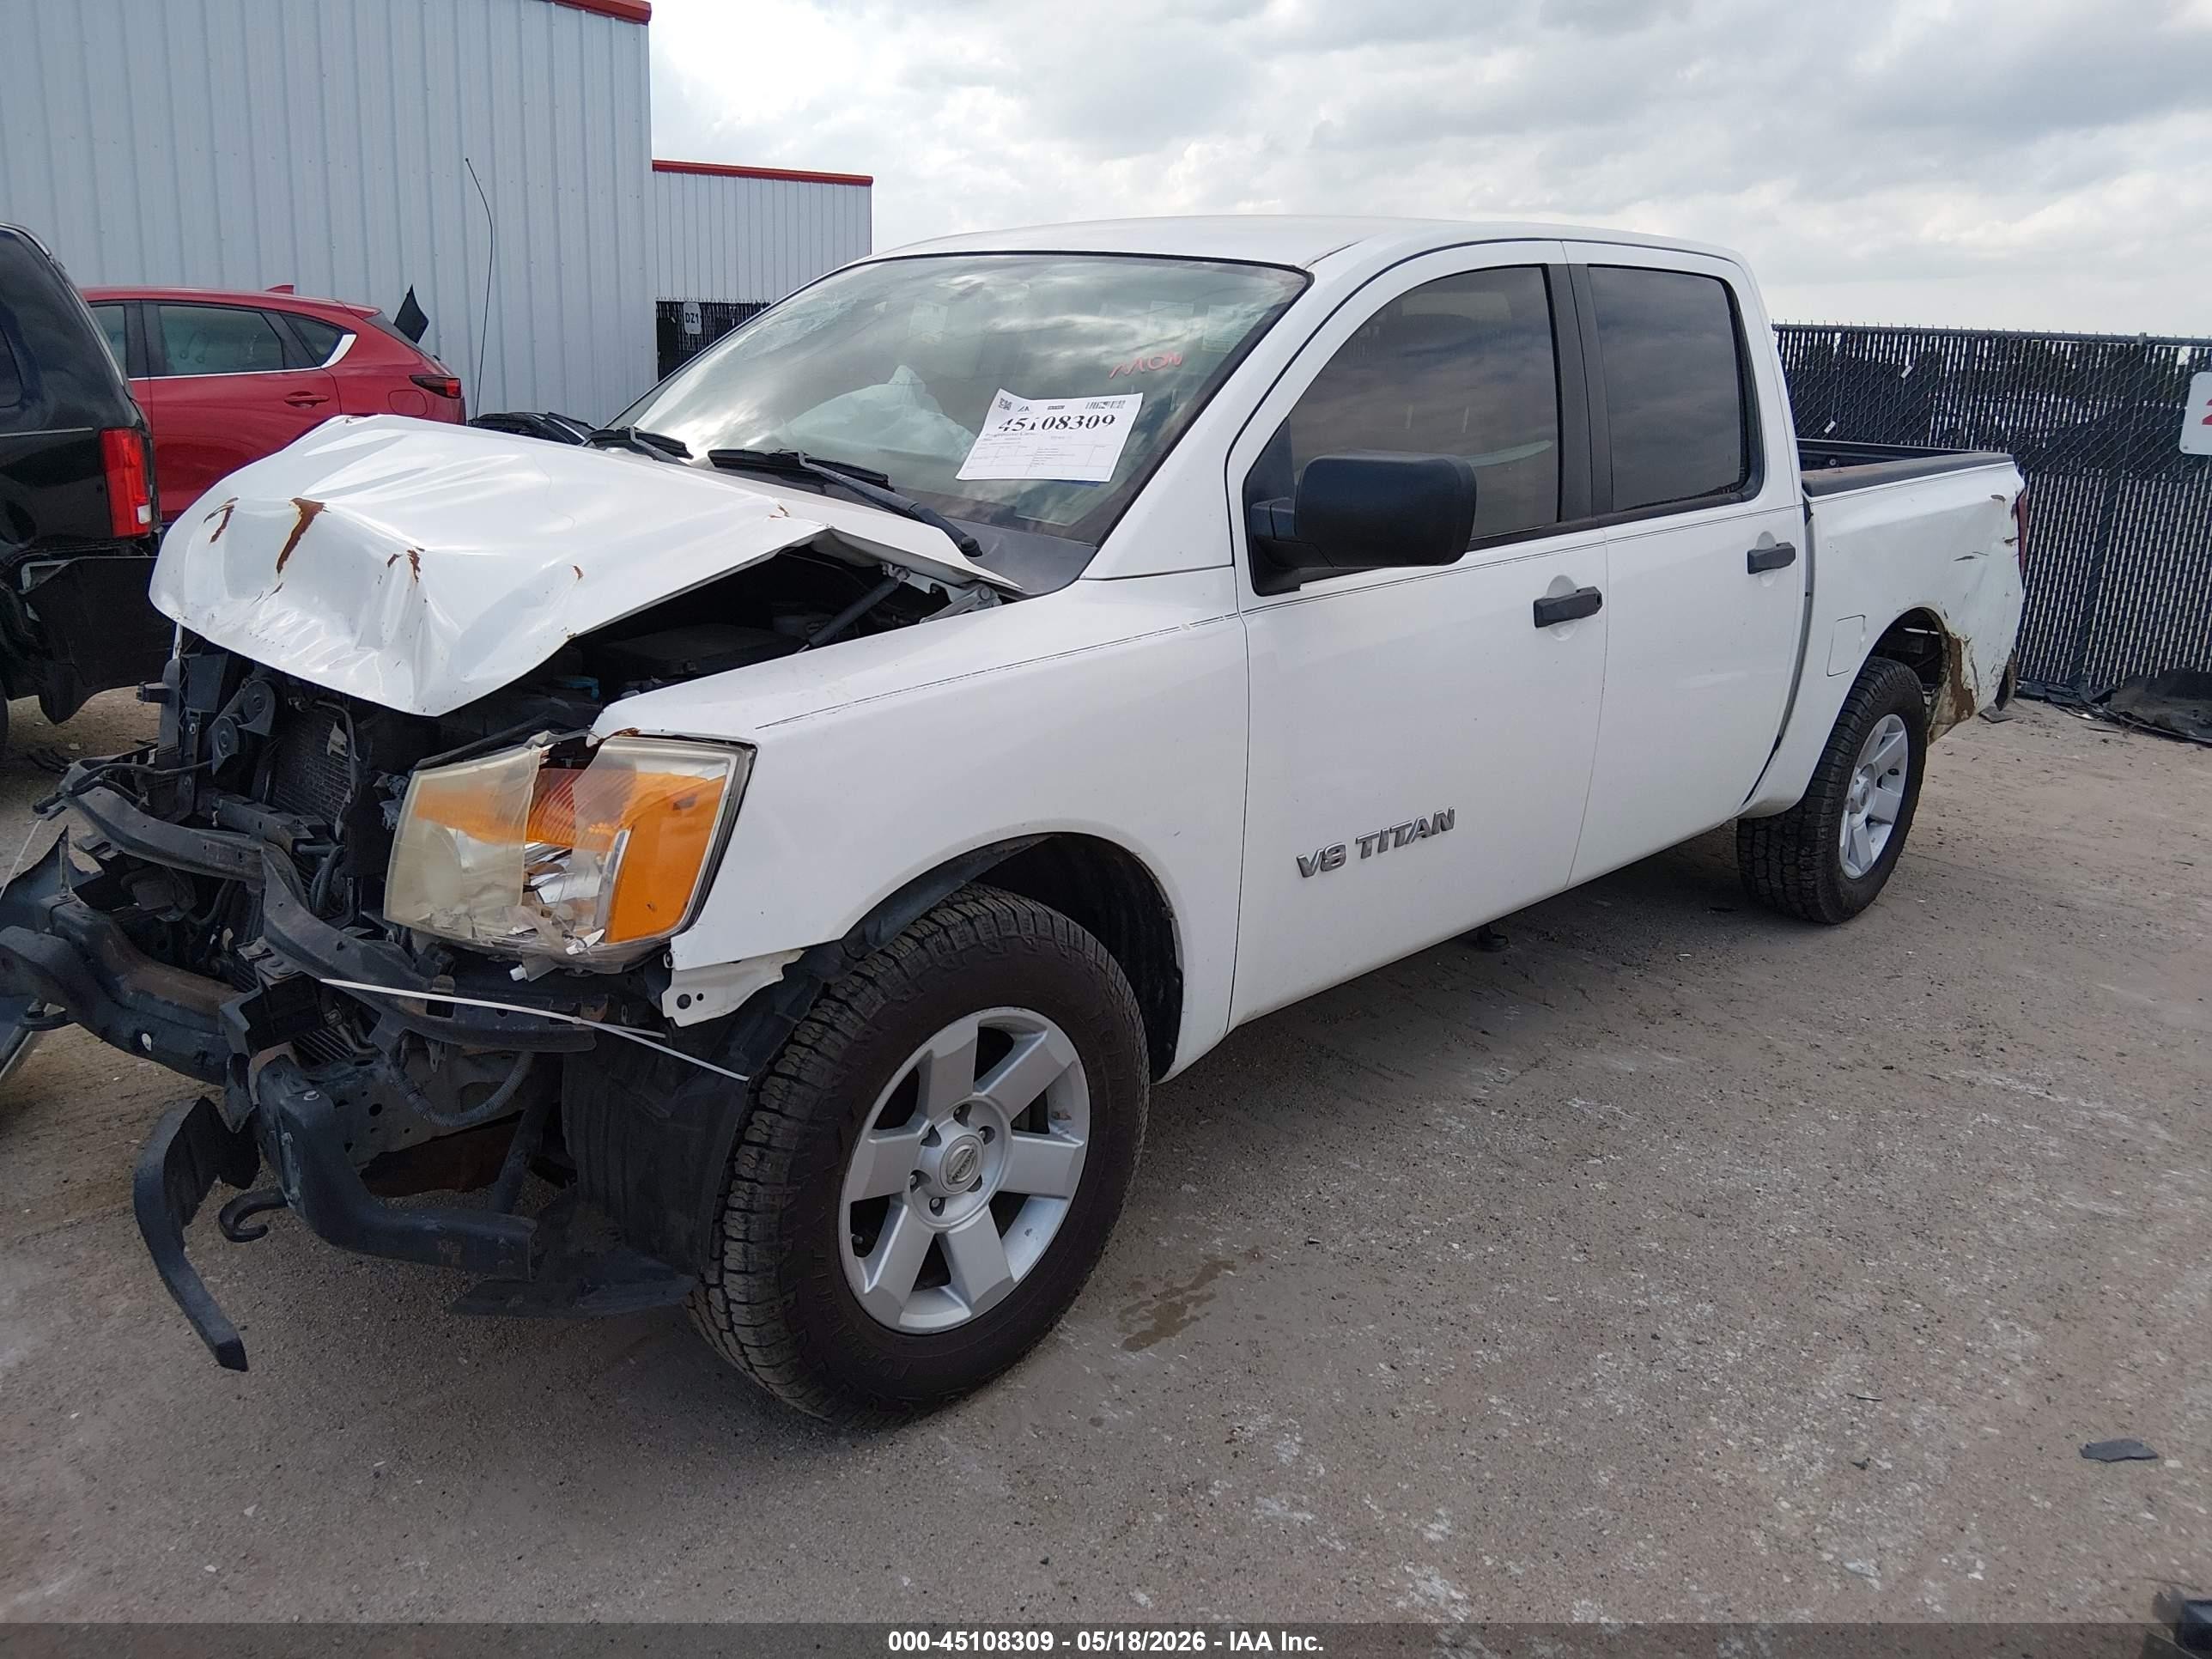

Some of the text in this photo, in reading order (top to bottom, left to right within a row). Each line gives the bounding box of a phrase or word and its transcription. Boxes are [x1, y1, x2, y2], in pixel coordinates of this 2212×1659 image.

[998, 413, 1116, 433] 45108309
[1296, 806, 1455, 878] V8 TITAN
